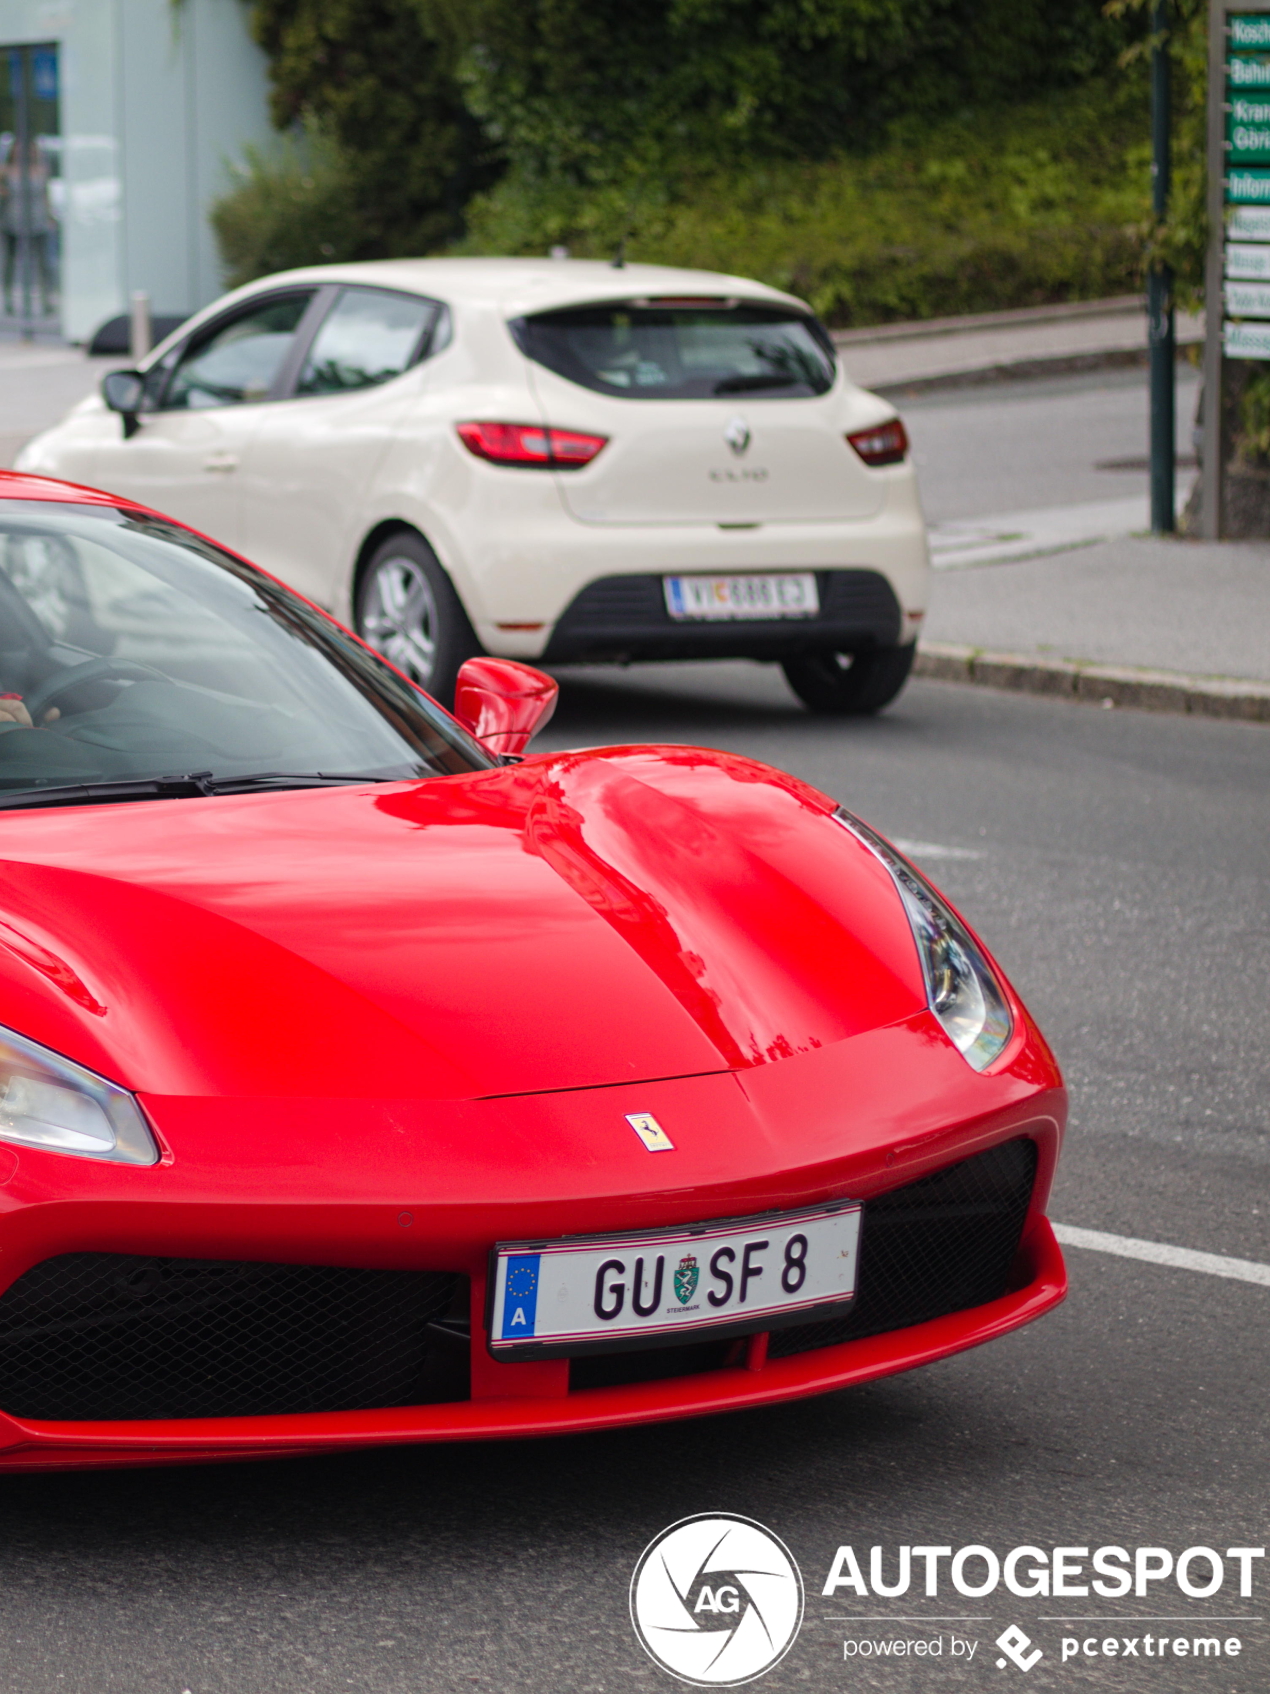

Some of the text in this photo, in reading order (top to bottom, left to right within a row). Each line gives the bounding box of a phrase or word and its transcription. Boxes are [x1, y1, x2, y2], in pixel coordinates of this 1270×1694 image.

[593, 1233, 809, 1321] GU SF 8
[510, 1307, 527, 1326] A
[666, 1304, 700, 1314] STEIERMARK
